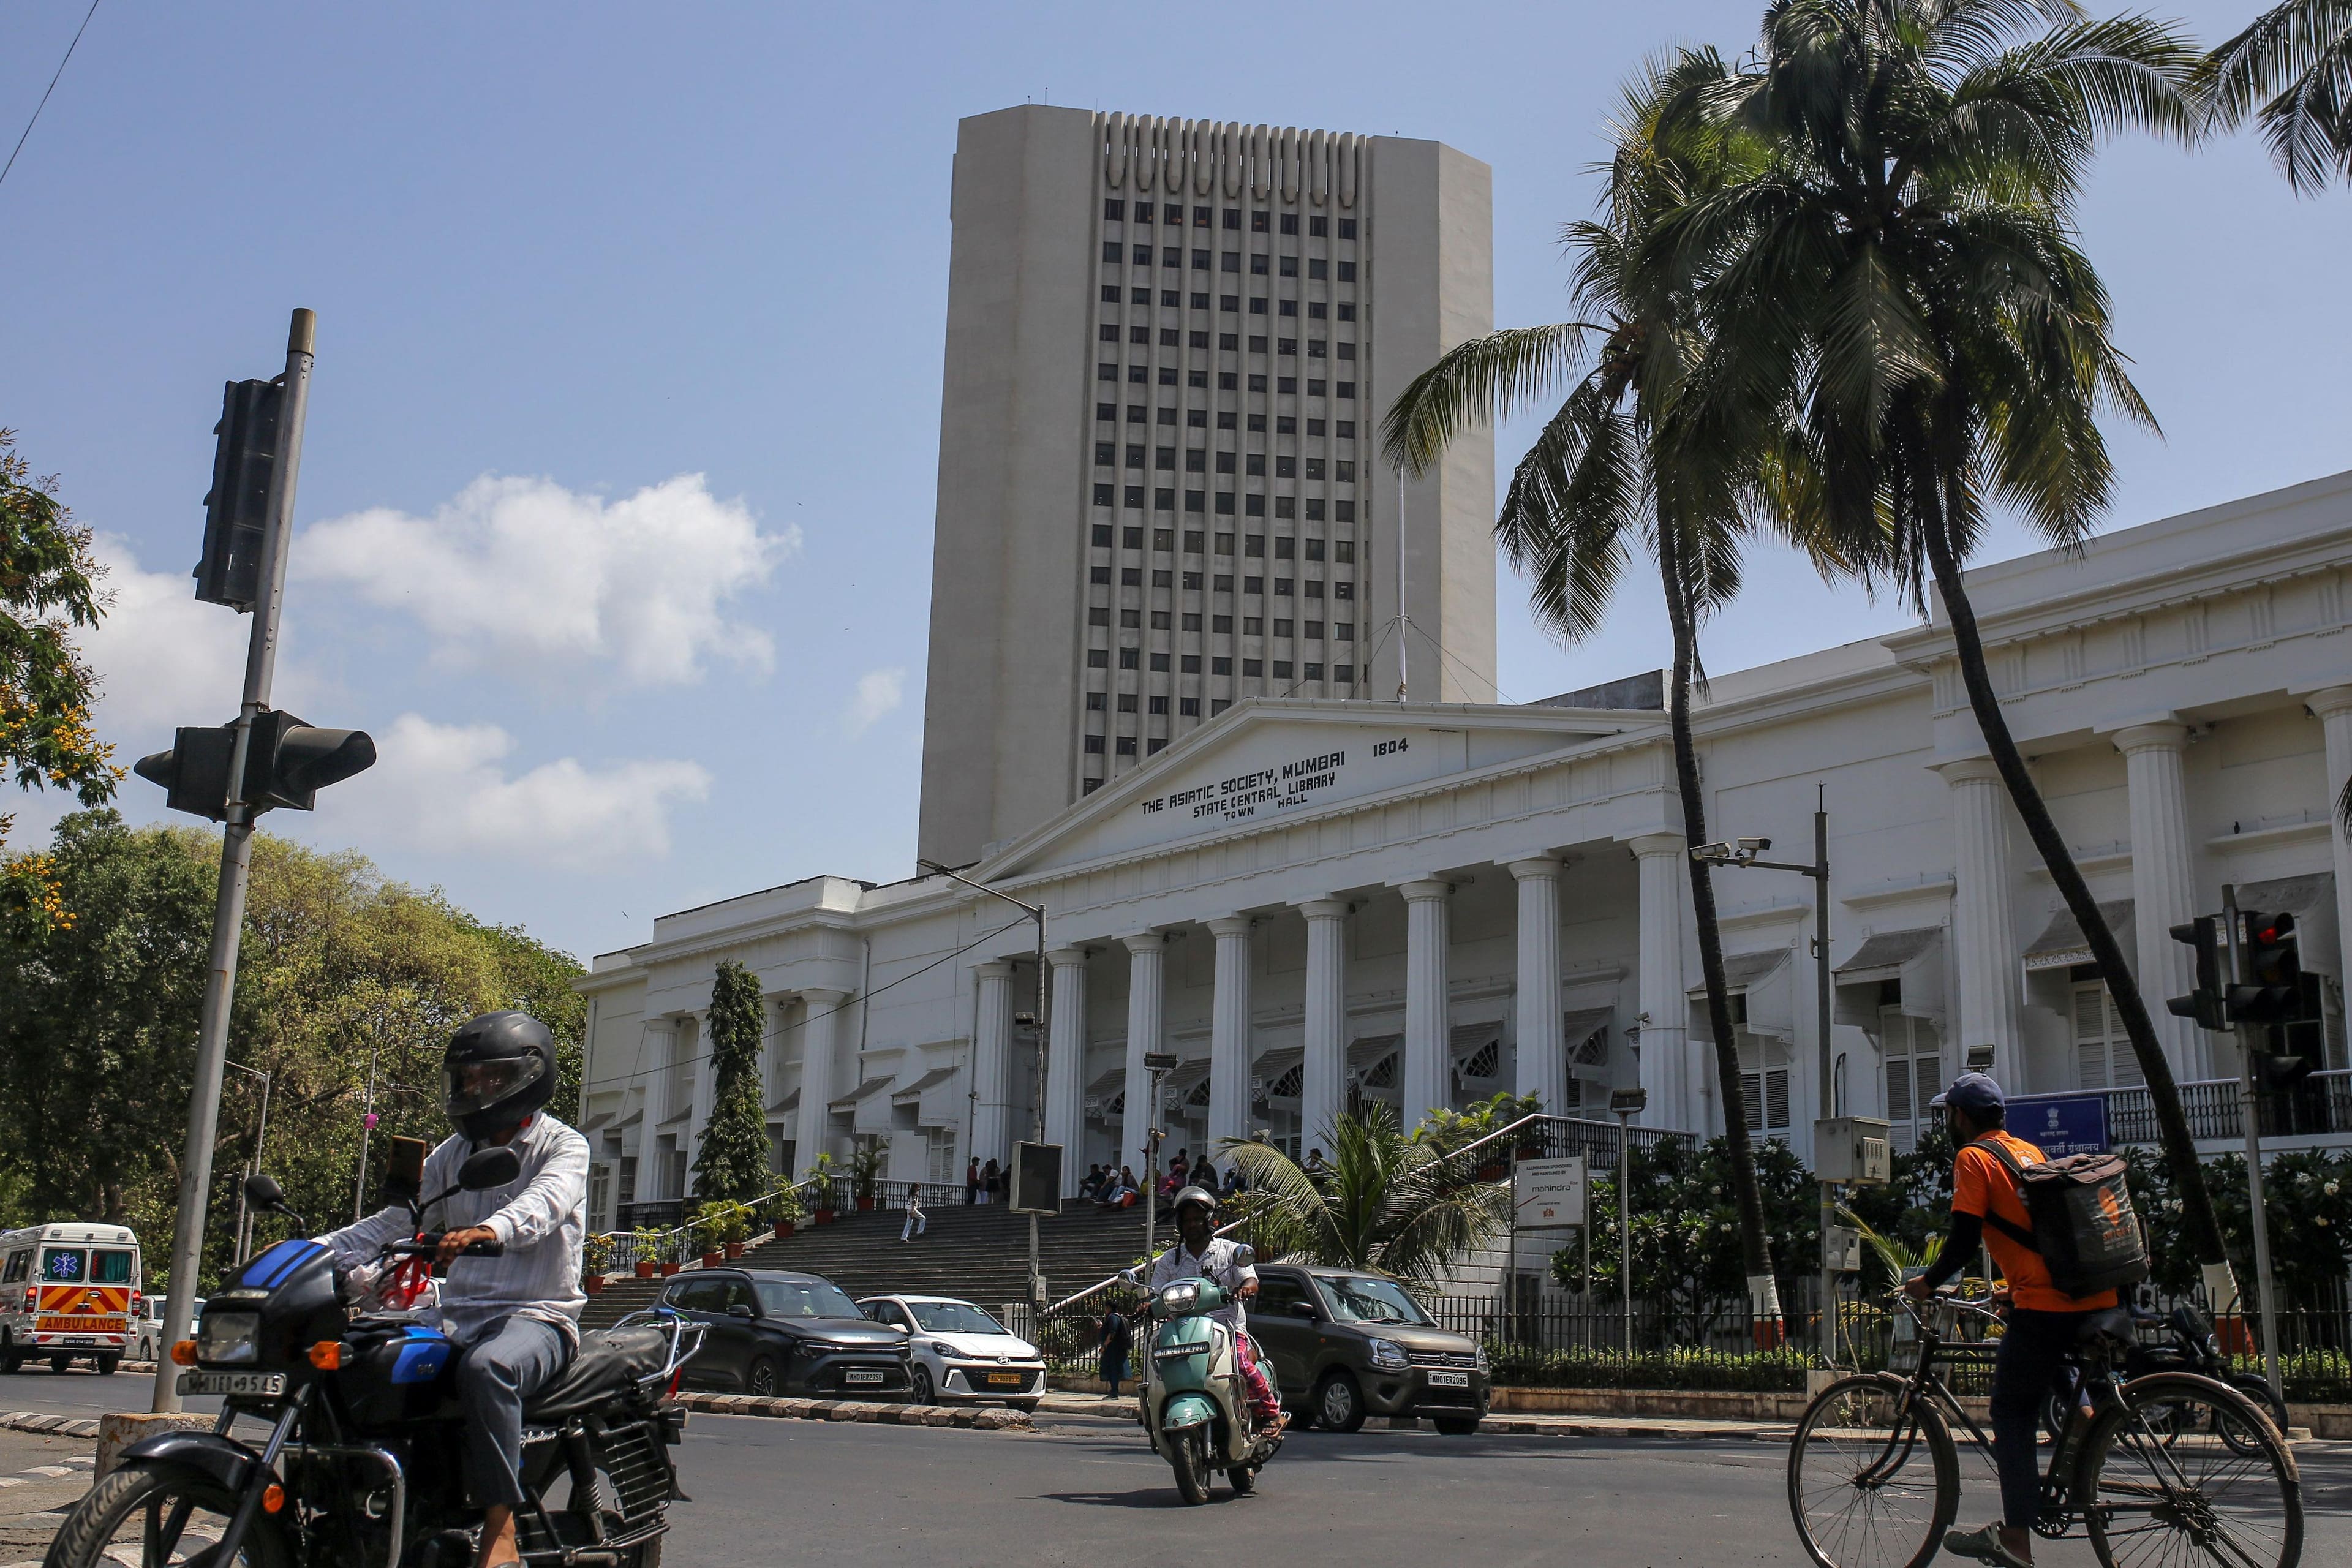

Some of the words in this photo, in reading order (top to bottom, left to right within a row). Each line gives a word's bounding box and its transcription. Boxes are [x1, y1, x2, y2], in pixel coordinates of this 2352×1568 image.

[1373, 737, 1409, 758] 1804
[1142, 799, 1163, 815] THE
[1170, 785, 1215, 809] ASIATIC
[1221, 769, 1278, 795] SOCIETY,
[1283, 751, 1345, 780] MUMBAI
[1193, 799, 1227, 818] STATE
[1231, 785, 1281, 809] CENTRAL
[1288, 771, 1335, 796] LIBRARY
[1224, 806, 1254, 822] TOWN
[1278, 794, 1308, 809] HALL
[1532, 1184, 1571, 1193] mahindra
[45, 1317, 123, 1330] AMBULANCE
[1432, 1374, 1467, 1385] MH01ER2096
